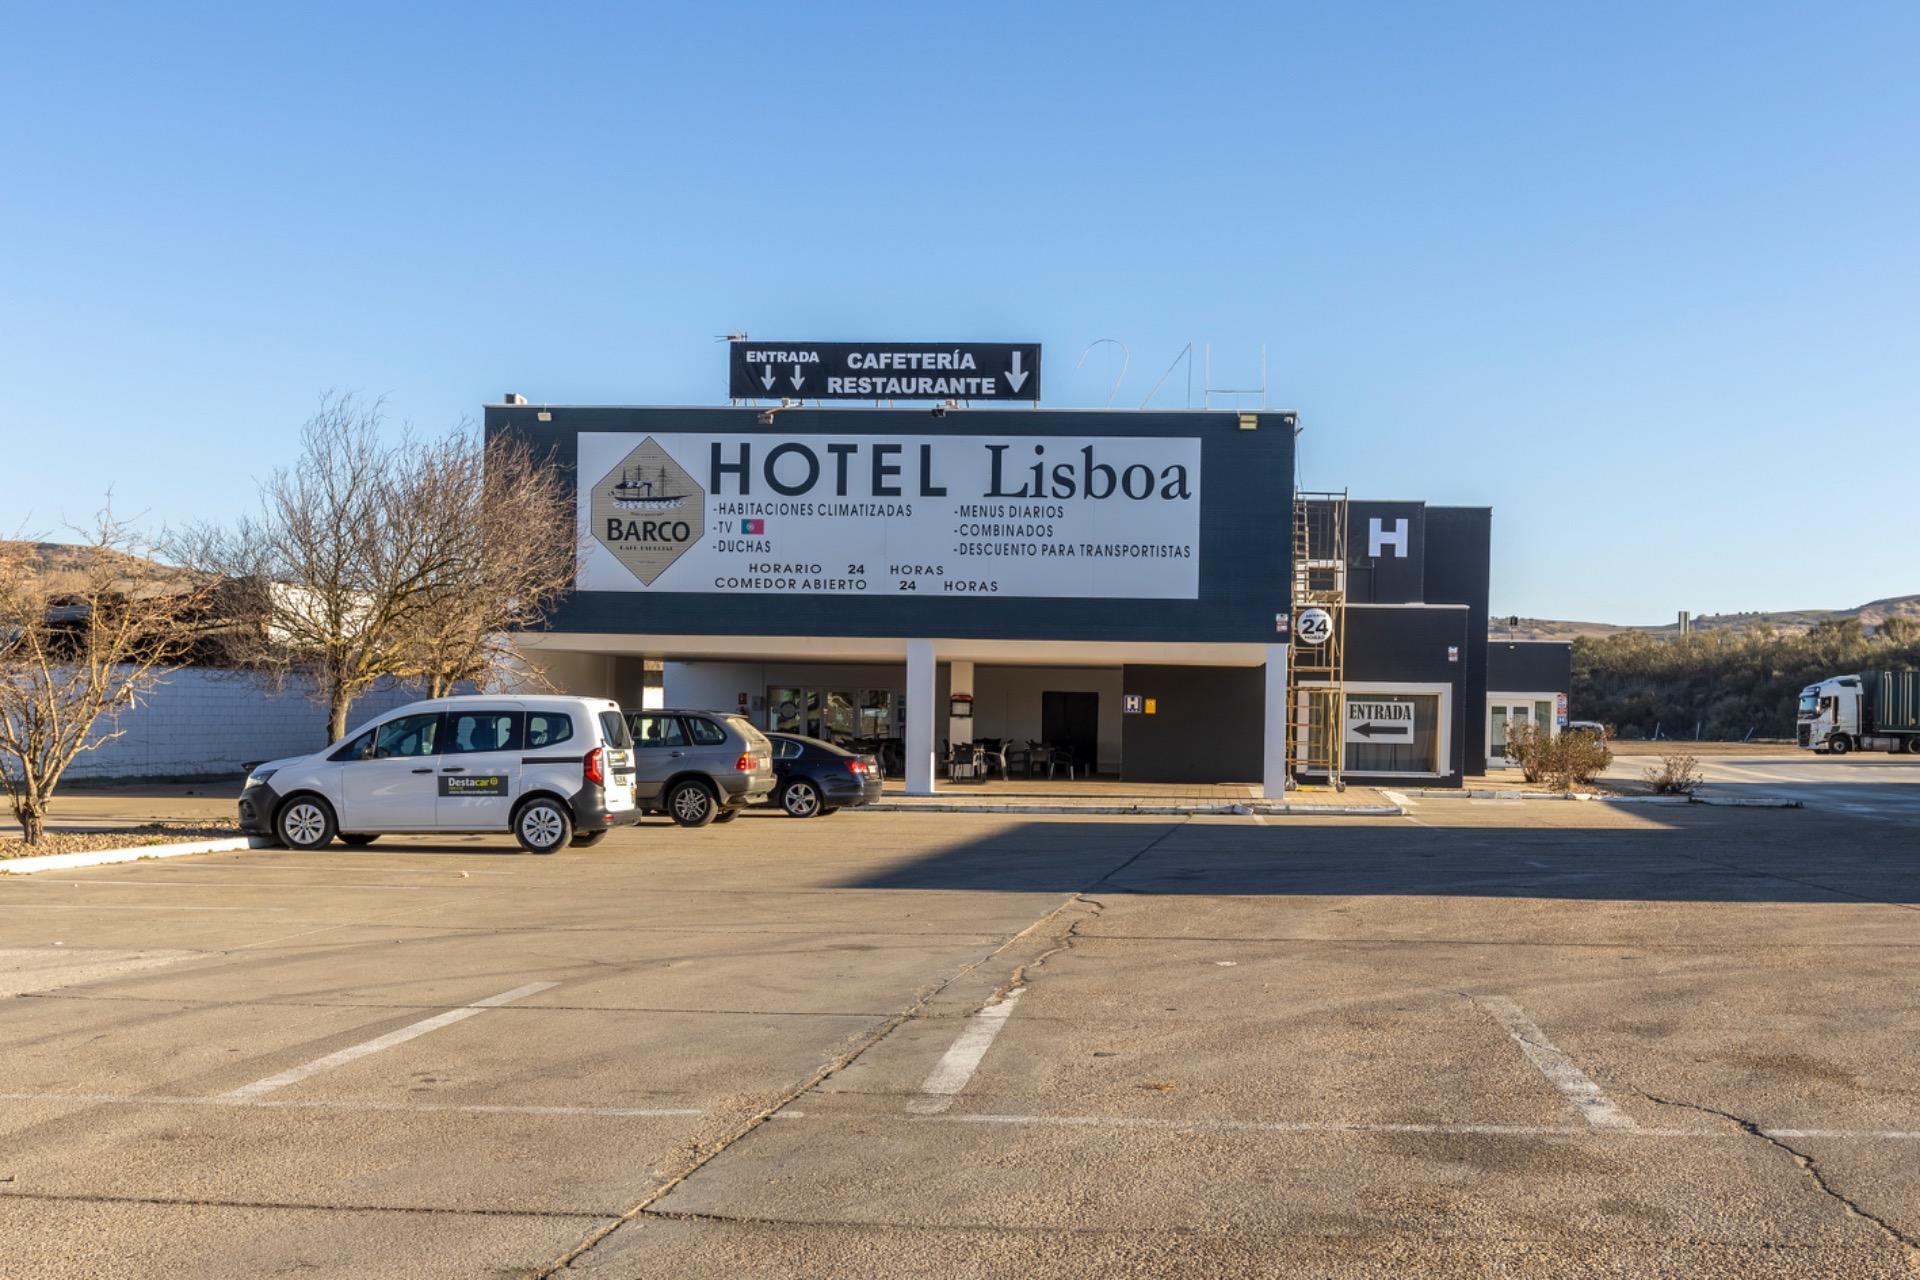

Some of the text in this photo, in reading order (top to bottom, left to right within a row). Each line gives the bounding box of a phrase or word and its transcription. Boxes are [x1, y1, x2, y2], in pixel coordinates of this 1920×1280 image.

[746, 351, 820, 363] ENTRADA
[847, 349, 976, 370] CAFETERÍA
[827, 377, 996, 394] RESTAURANTE
[710, 442, 1192, 500] HOTEL Lisboa
[817, 503, 912, 517] CLIMATIZADAS
[1008, 505, 1064, 518] DIARIOS
[607, 518, 690, 542] BARCO
[1368, 518, 1408, 557] H
[1041, 544, 1076, 557] PARA
[1079, 544, 1191, 558] TRANSPORTISTAS
[748, 563, 945, 575] HORARIO 24 HORAS
[714, 577, 999, 592] COMEDOR ABIERTO 24 HORAS
[1302, 619, 1329, 635] 24
[1126, 696, 1139, 709] H
[1349, 704, 1412, 720] ENTRADA
[448, 777, 489, 787] Destacar
